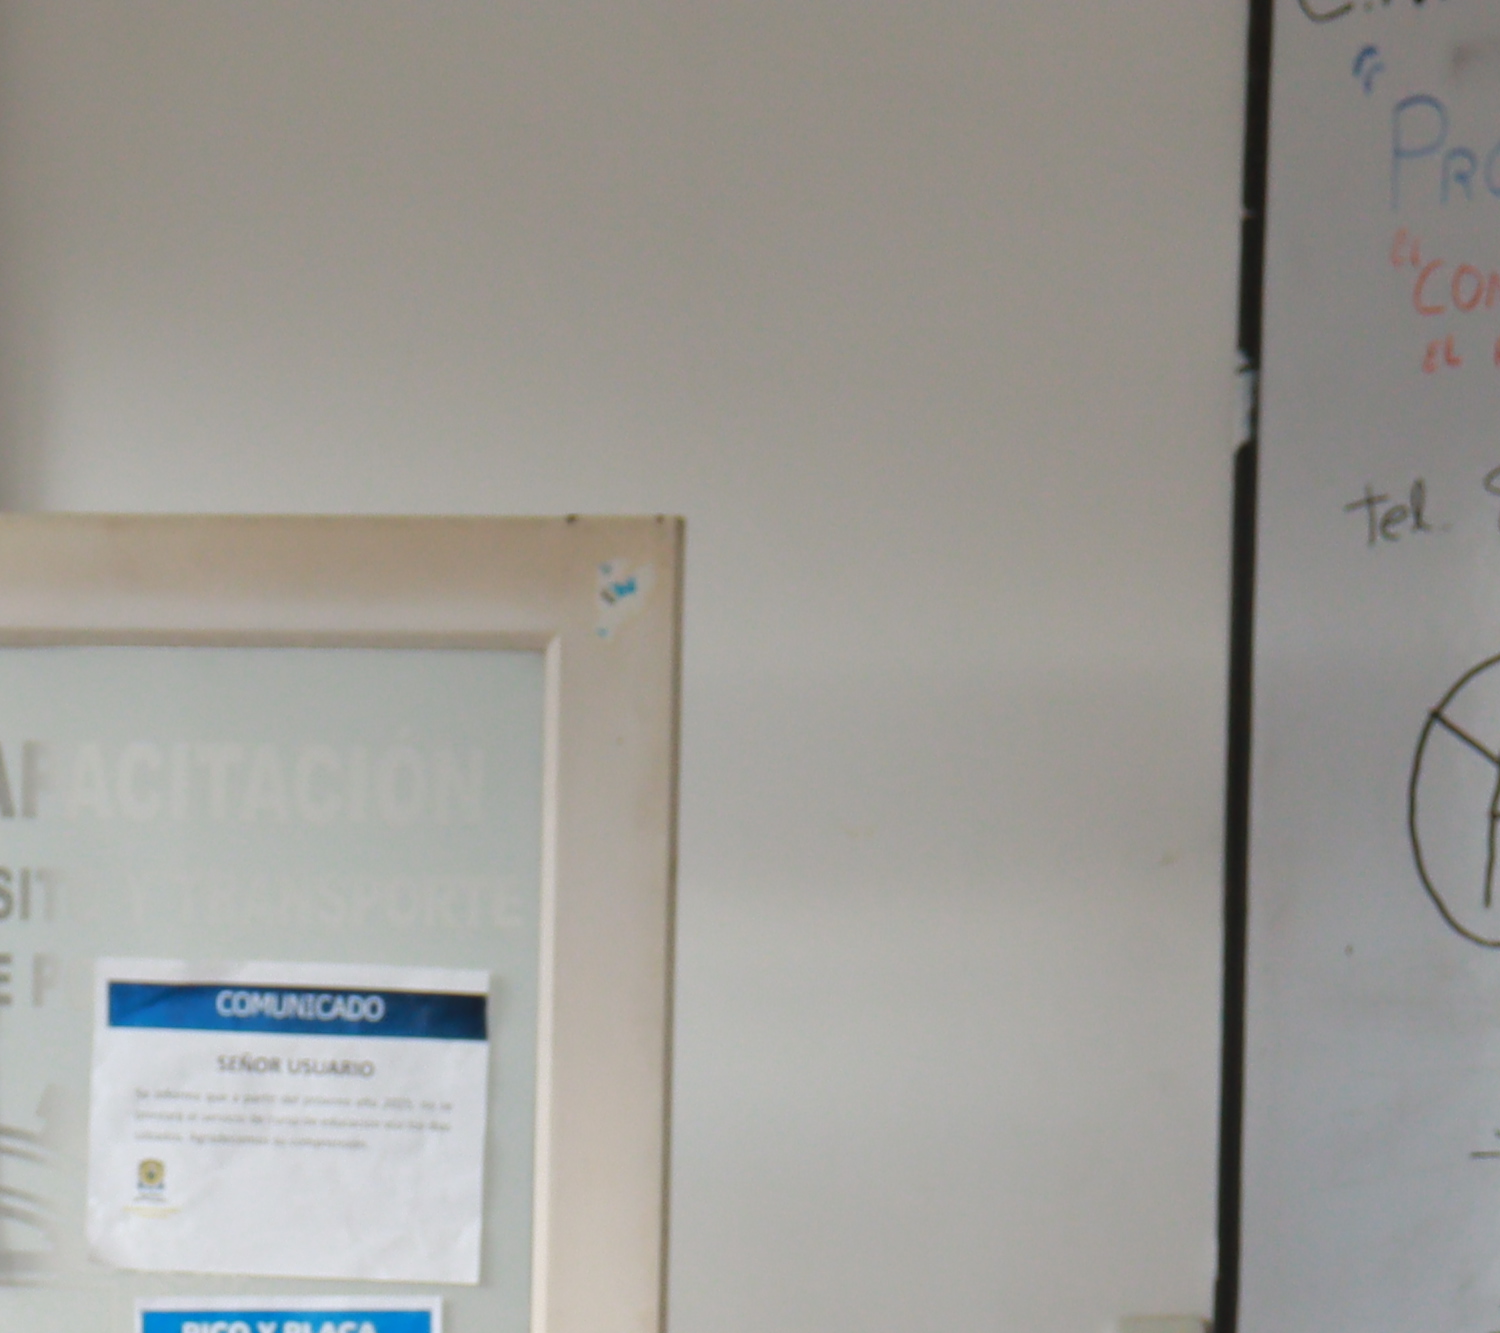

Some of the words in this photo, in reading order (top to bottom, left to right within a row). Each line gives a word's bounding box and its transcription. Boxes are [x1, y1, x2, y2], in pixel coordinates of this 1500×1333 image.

[215, 989, 387, 1022] COMUNICADO
[217, 1051, 282, 1075] SEÑOR
[288, 1058, 376, 1079] USUARIO
